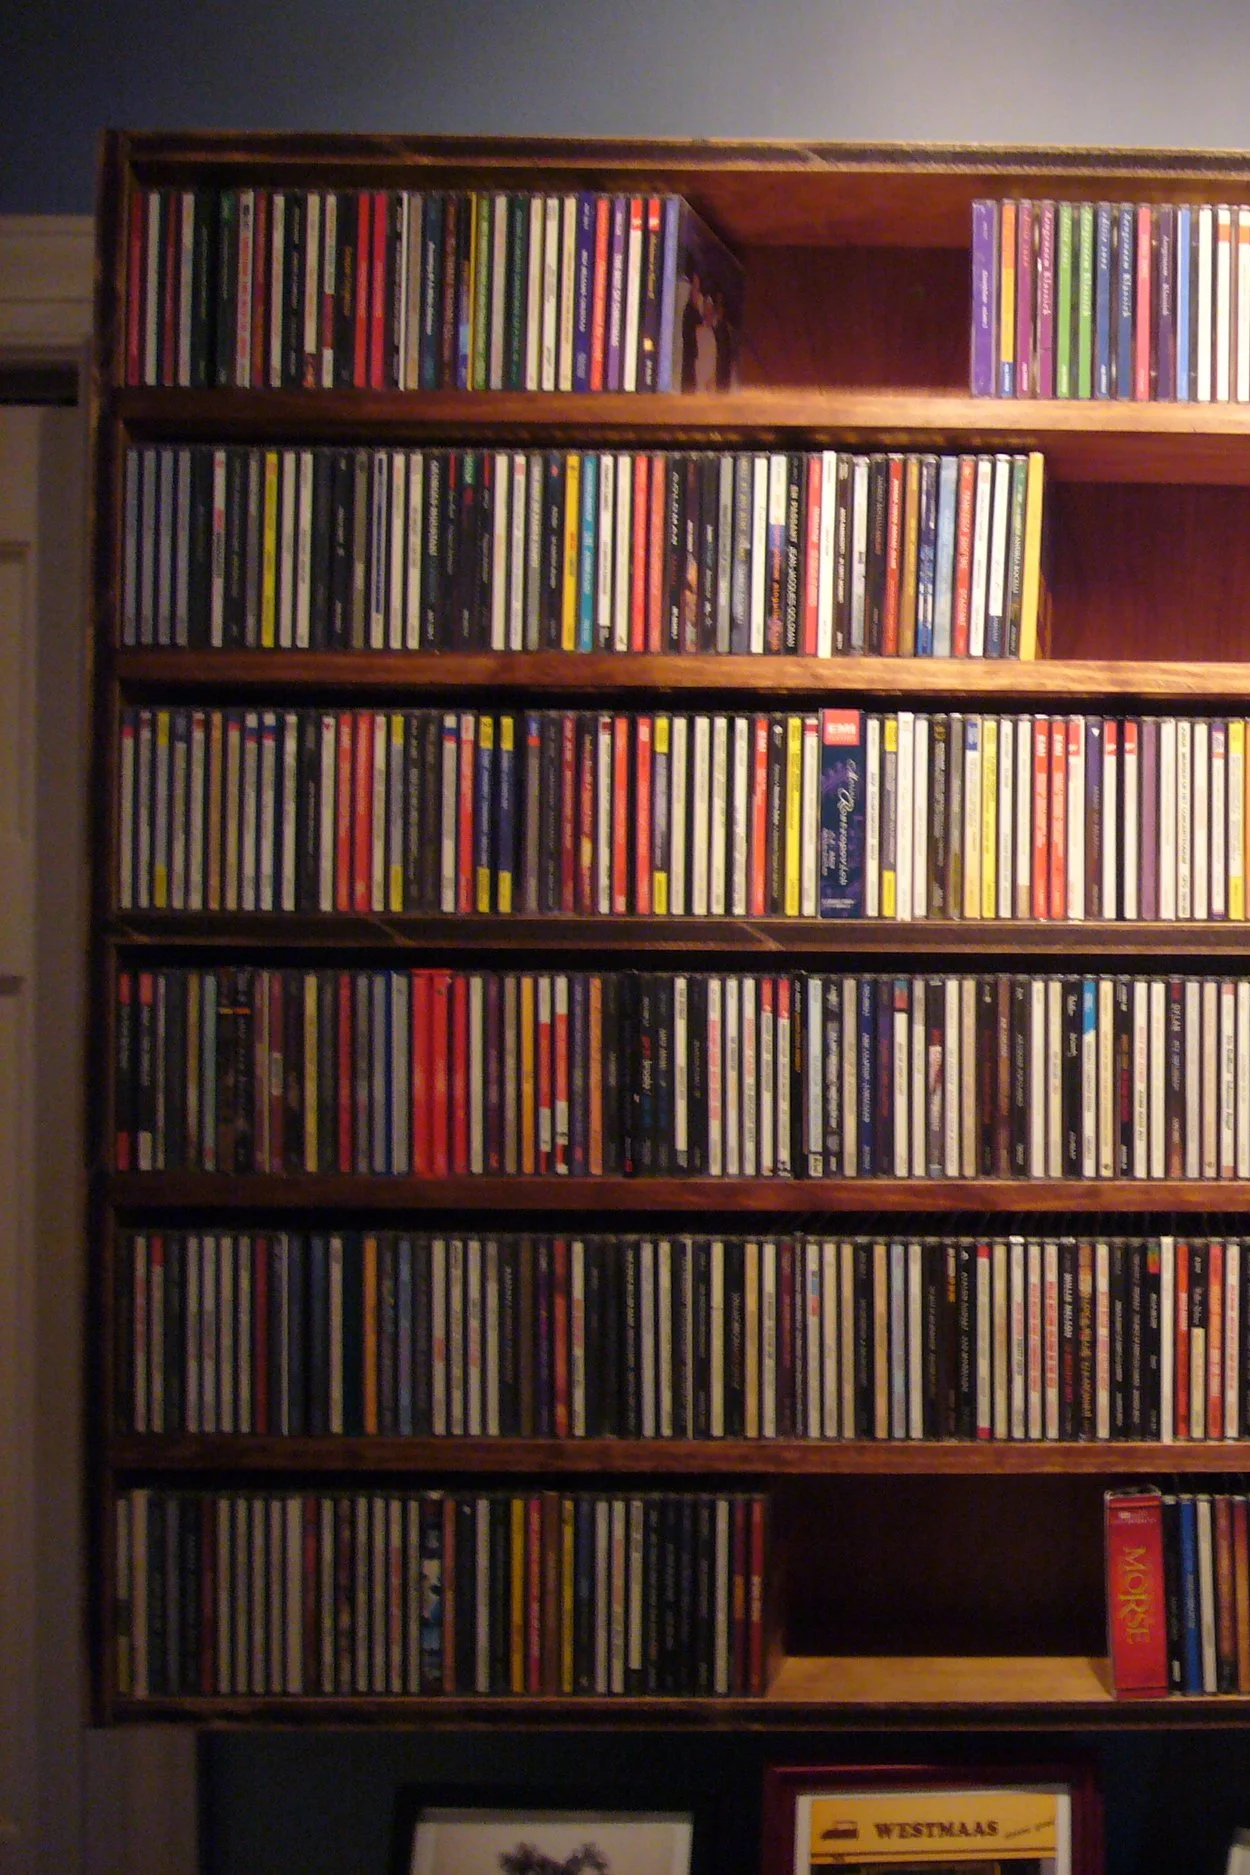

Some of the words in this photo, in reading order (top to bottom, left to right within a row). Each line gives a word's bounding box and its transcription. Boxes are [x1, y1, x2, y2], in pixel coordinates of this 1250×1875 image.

[827, 722, 856, 736] EMI
[1118, 1543, 1152, 1644] MORSE
[872, 1820, 999, 1839] WESTMAAS
